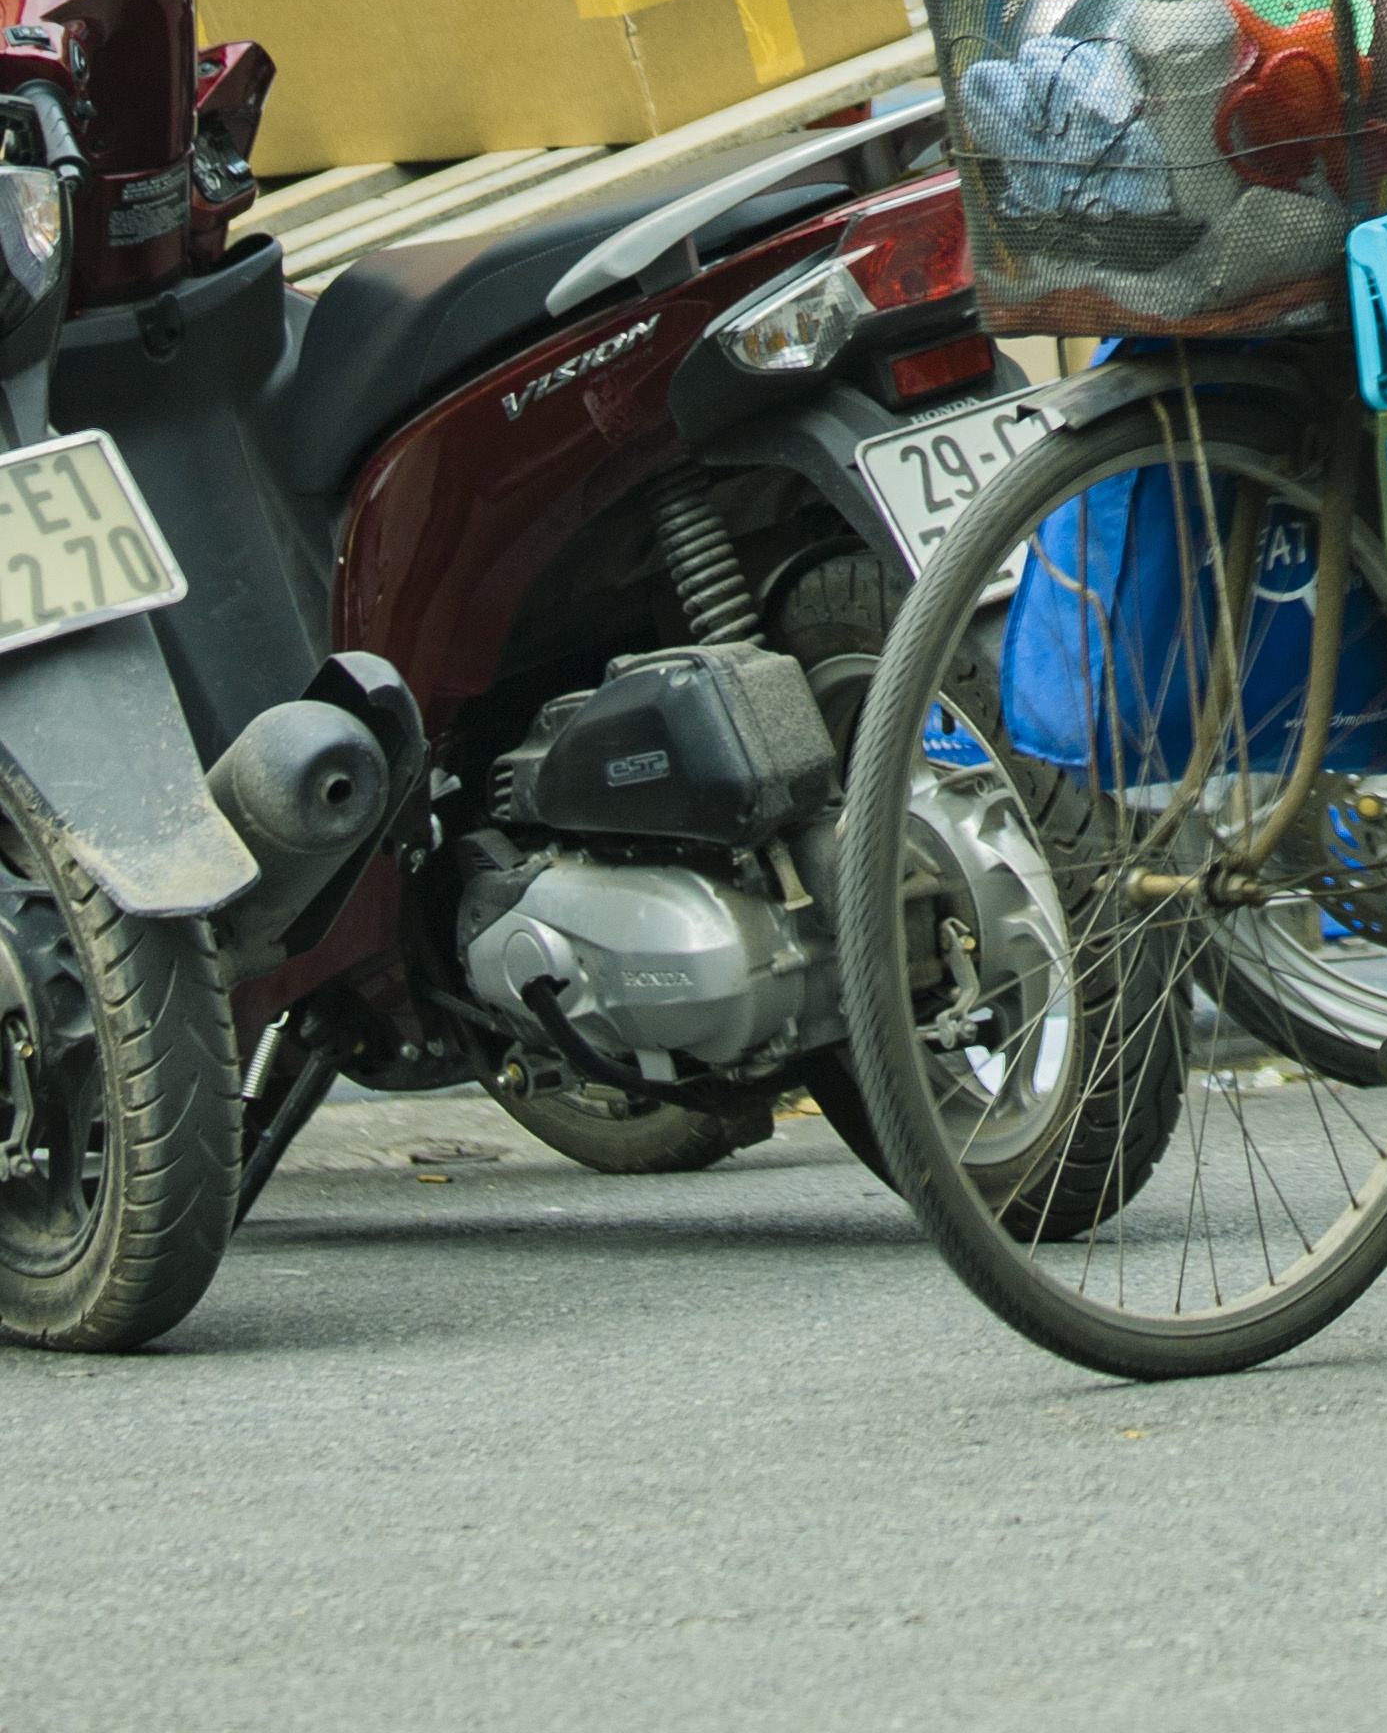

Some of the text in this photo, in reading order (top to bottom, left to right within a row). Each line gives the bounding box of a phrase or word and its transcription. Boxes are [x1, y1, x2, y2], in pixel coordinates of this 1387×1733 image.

[501, 313, 661, 421] VISION
[909, 396, 981, 425] HONDA
[621, 970, 693, 988] HONDA
